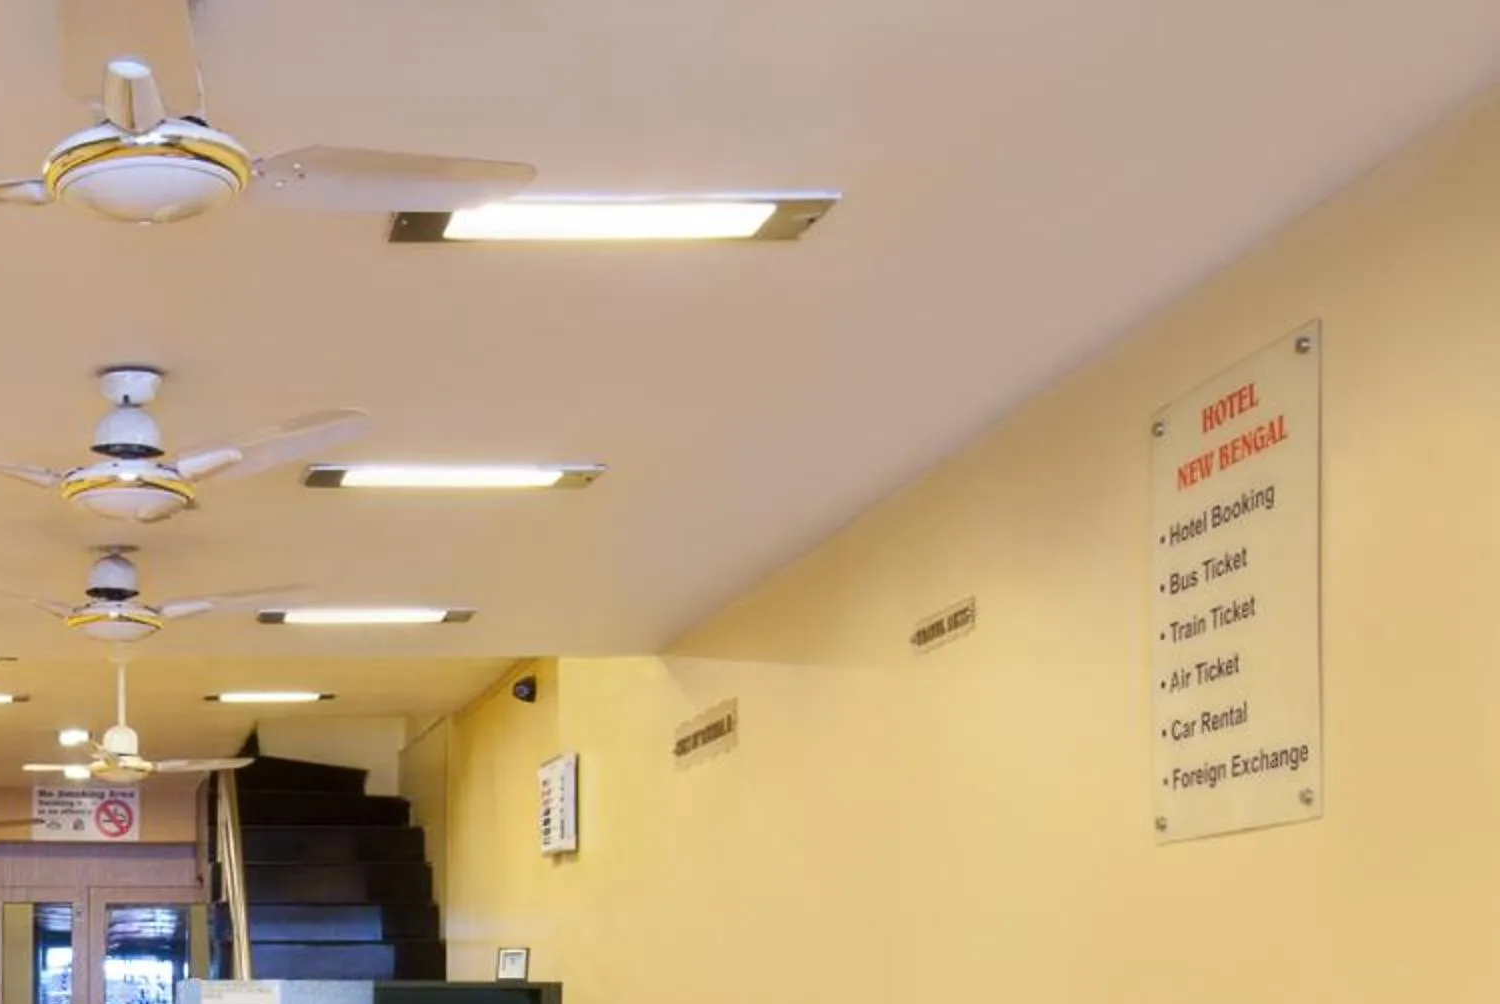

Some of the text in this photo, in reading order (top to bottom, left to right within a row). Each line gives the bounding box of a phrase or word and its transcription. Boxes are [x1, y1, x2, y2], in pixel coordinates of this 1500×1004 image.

[1202, 383, 1258, 434] HOTEL
[1176, 415, 1288, 491] NEW BENGAL
[1169, 485, 1275, 546] Hotel Booking
[1169, 547, 1248, 595] Bus Ticket
[1170, 596, 1255, 643] Train Ticket
[1169, 653, 1239, 692] Air Ticket
[1171, 701, 1247, 741] Car Rental
[1172, 744, 1309, 790] Foreign Exchange
[38, 789, 135, 800] No Smoking Area
